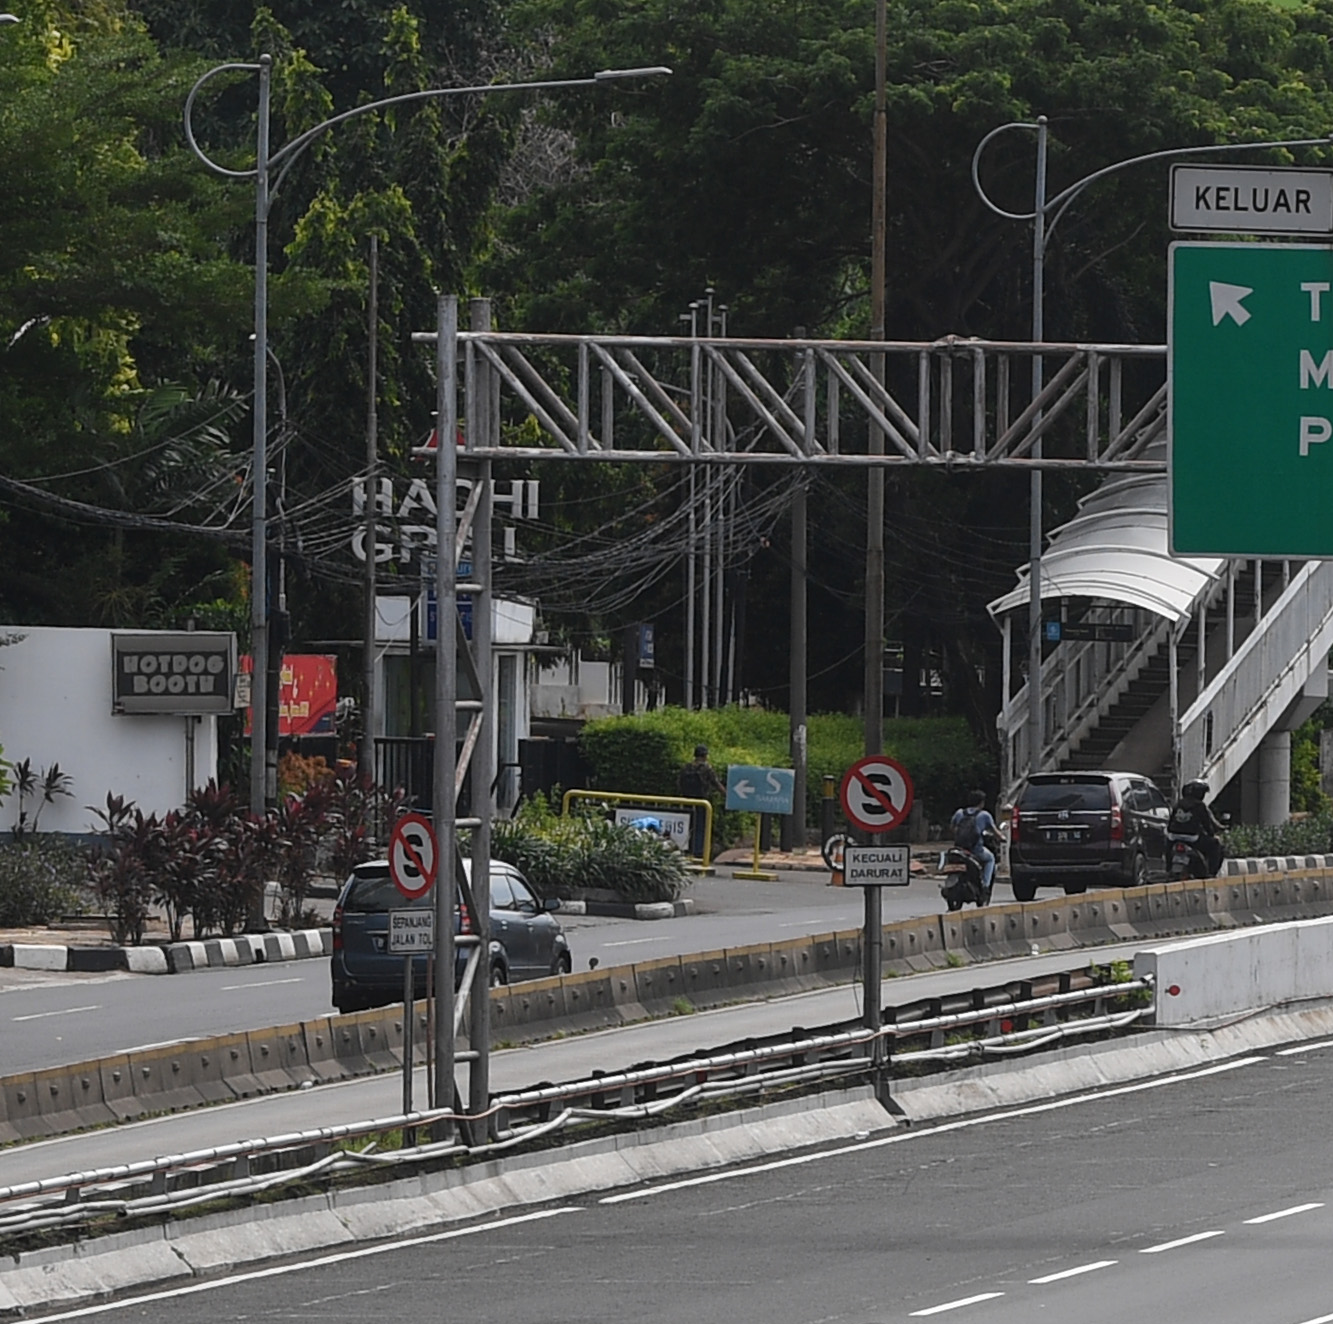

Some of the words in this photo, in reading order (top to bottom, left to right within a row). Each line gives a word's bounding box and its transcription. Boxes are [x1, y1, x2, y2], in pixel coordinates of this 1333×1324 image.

[1195, 185, 1311, 215] KELUAR
[352, 525, 526, 565] GRL
[123, 654, 224, 675] HOTDOG
[133, 674, 215, 694] BOOTH
[852, 853, 902, 863] KECUALI
[850, 868, 903, 879] DARURAT
[392, 914, 432, 930] SEPANJANG
[392, 933, 415, 946] JALAN
[418, 932, 433, 946] TOL
